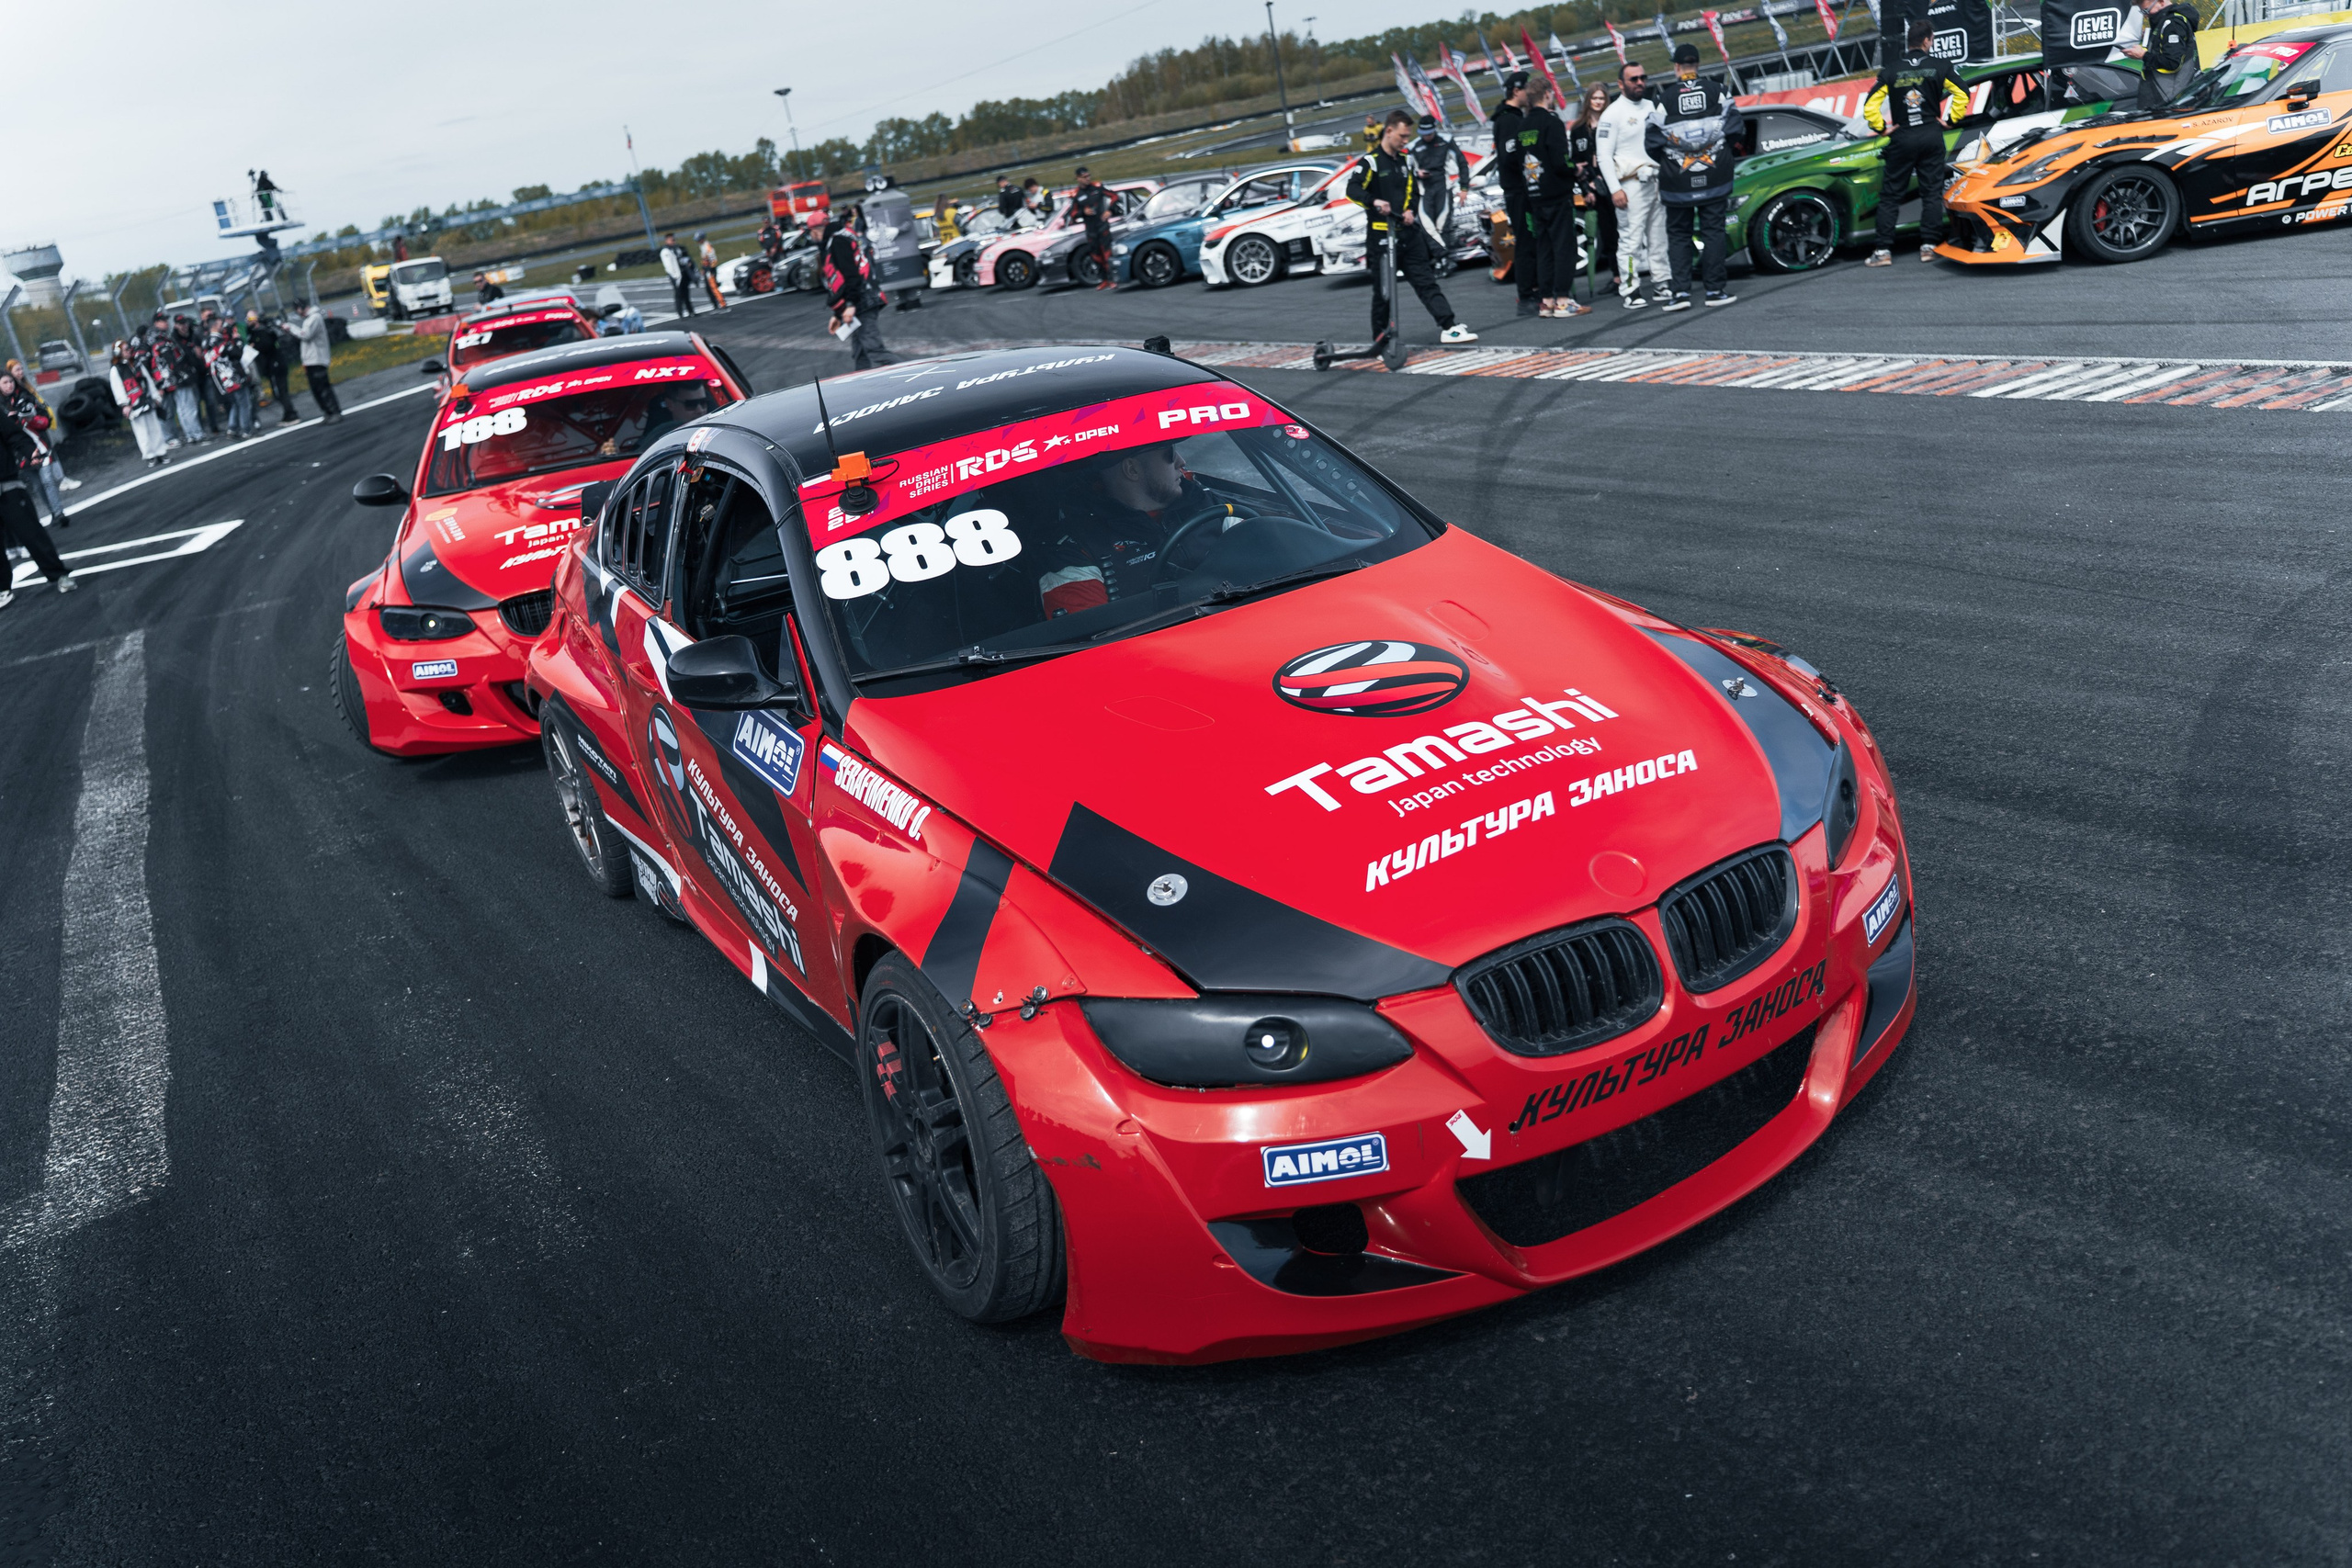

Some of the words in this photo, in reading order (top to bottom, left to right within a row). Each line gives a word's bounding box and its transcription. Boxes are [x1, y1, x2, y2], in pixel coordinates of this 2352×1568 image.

[2076, 14, 2114, 34] LEVEL
[2076, 28, 2114, 42] KITCHEN
[2270, 112, 2329, 131] AIMOL
[2295, 205, 2348, 222] POWER
[455, 331, 493, 350] 127
[634, 366, 695, 380] NXT
[437, 407, 528, 452] 188
[1158, 402, 1251, 430] PRO
[956, 439, 1038, 481] RDS
[1075, 424, 1119, 443] OPEN
[899, 465, 948, 489] RUSSIAN
[909, 479, 949, 499] SERIES
[915, 472, 948, 490] DRIFT
[527, 535, 564, 548] Japan
[815, 508, 1023, 601] 888
[499, 545, 568, 570] КУЛЬТ
[415, 663, 455, 677] AIMOL
[737, 714, 797, 777] AIMOL
[1264, 687, 1620, 813] Tamashi
[1386, 776, 1464, 818] Japan
[1462, 734, 1603, 789] technology
[834, 755, 920, 831] SERAFIMENKO
[908, 806, 932, 841] O.
[1364, 790, 1555, 893] КУЛЬТУРА
[1567, 749, 1699, 808] ЗАНОСА
[687, 758, 744, 848] КУЛЬТУРА
[745, 845, 799, 922] ЗАНОСА
[689, 784, 806, 976] Tamashi
[1868, 884, 1899, 937] AIMOL
[1515, 1022, 1711, 1132] КУЛЬТУРА
[1717, 957, 1827, 1050] ЗАНОСА
[1271, 1144, 1381, 1179] AIMOL
